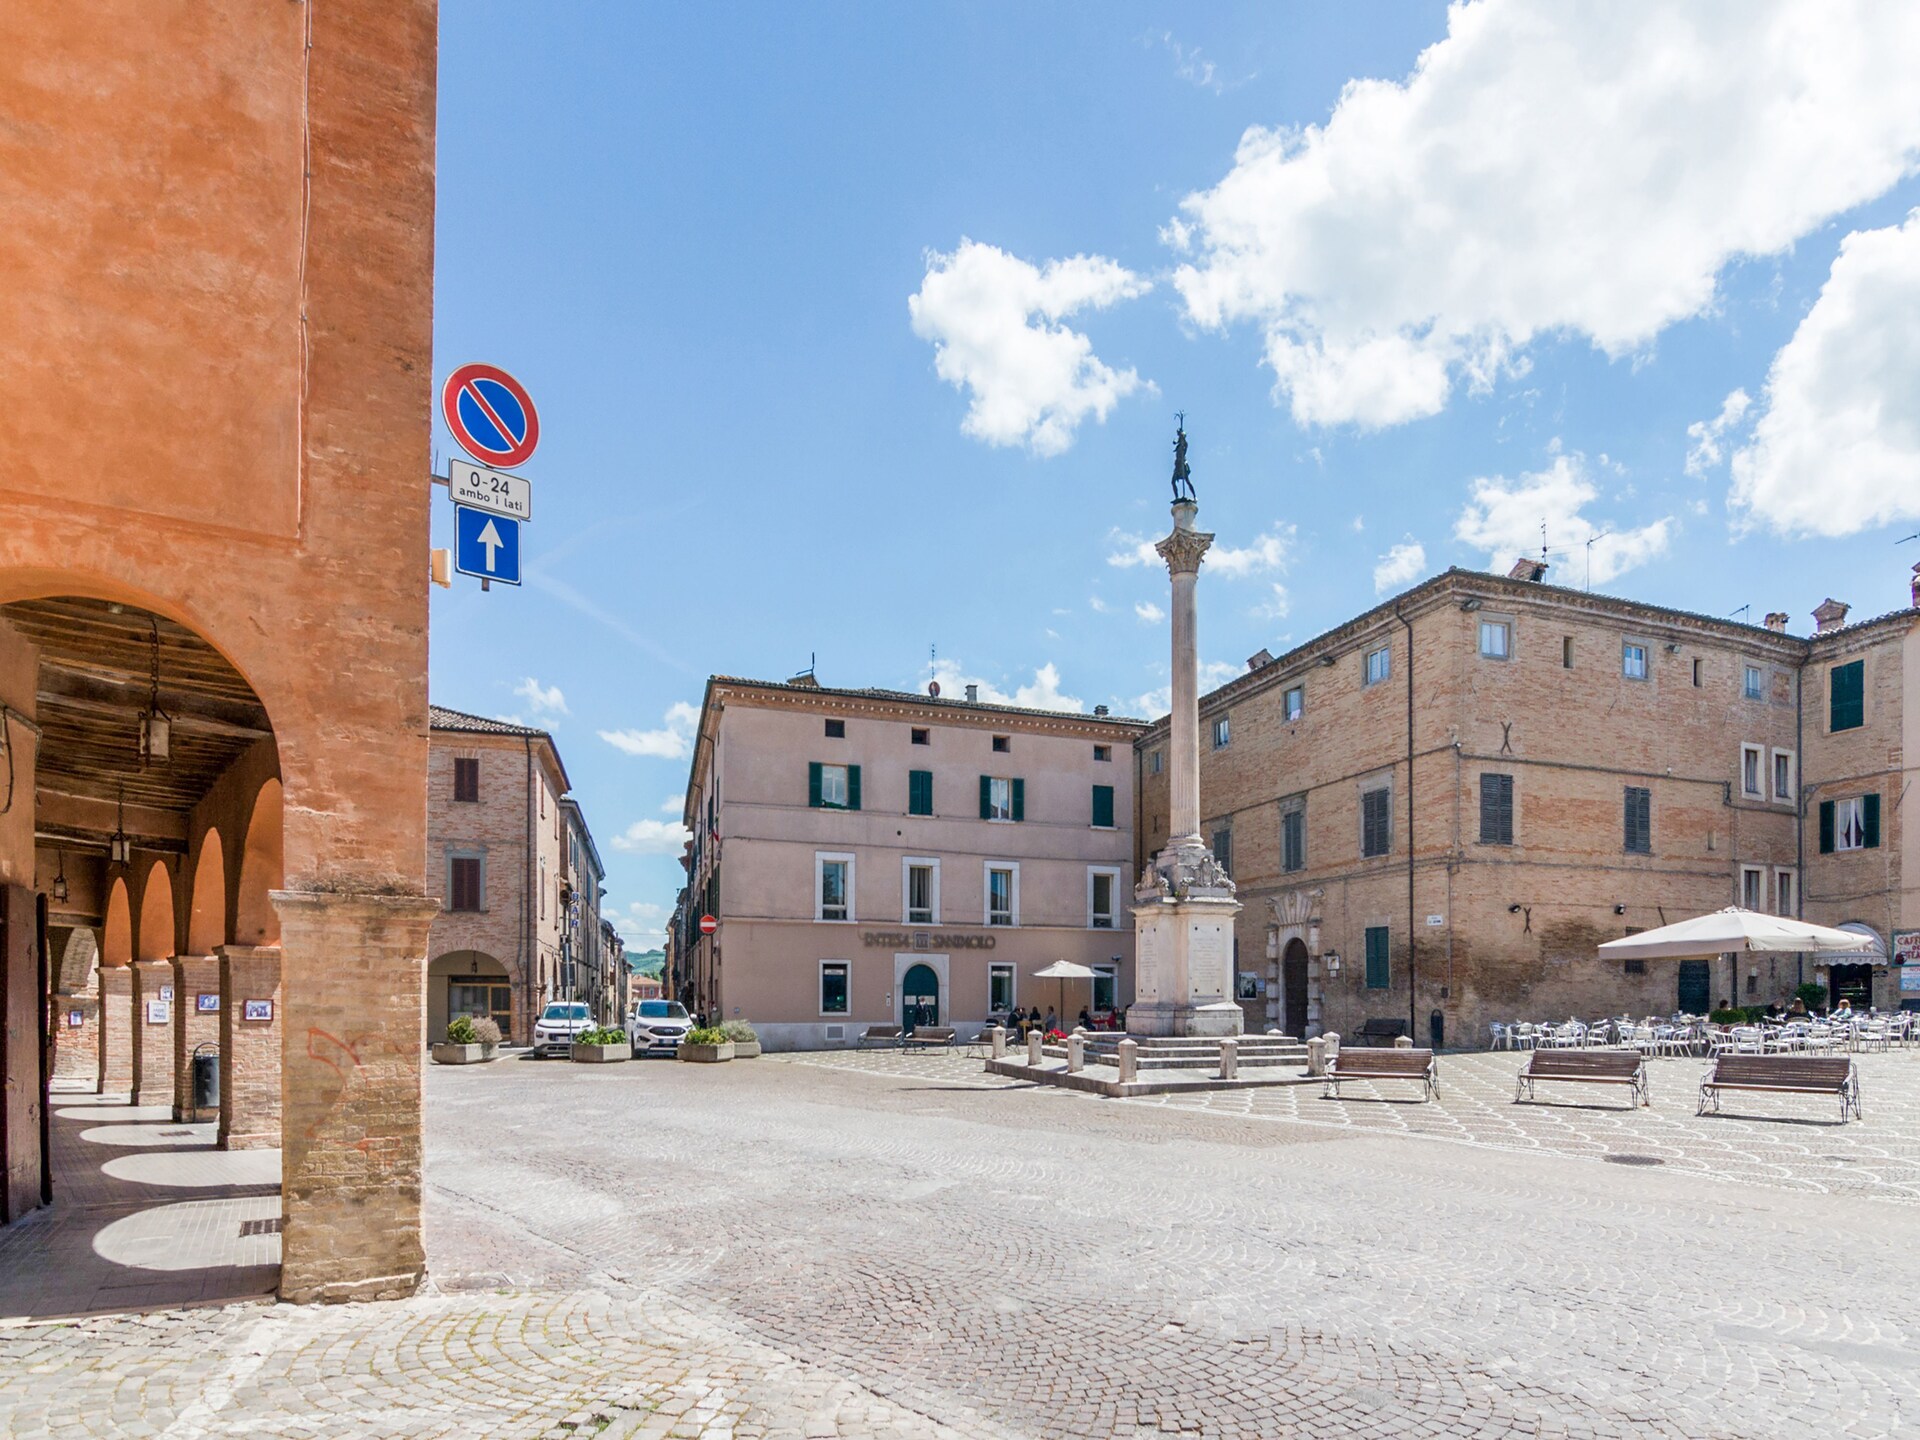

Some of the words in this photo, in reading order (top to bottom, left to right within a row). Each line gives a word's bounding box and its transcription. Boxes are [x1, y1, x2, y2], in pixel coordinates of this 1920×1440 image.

[470, 472, 510, 496] 0-24
[459, 487, 490, 502] ambo
[495, 495, 499, 505] i
[504, 498, 522, 511] lati
[571, 892, 580, 928] BAR
[863, 932, 909, 948] INTESA
[932, 933, 996, 950] SANPAOLO
